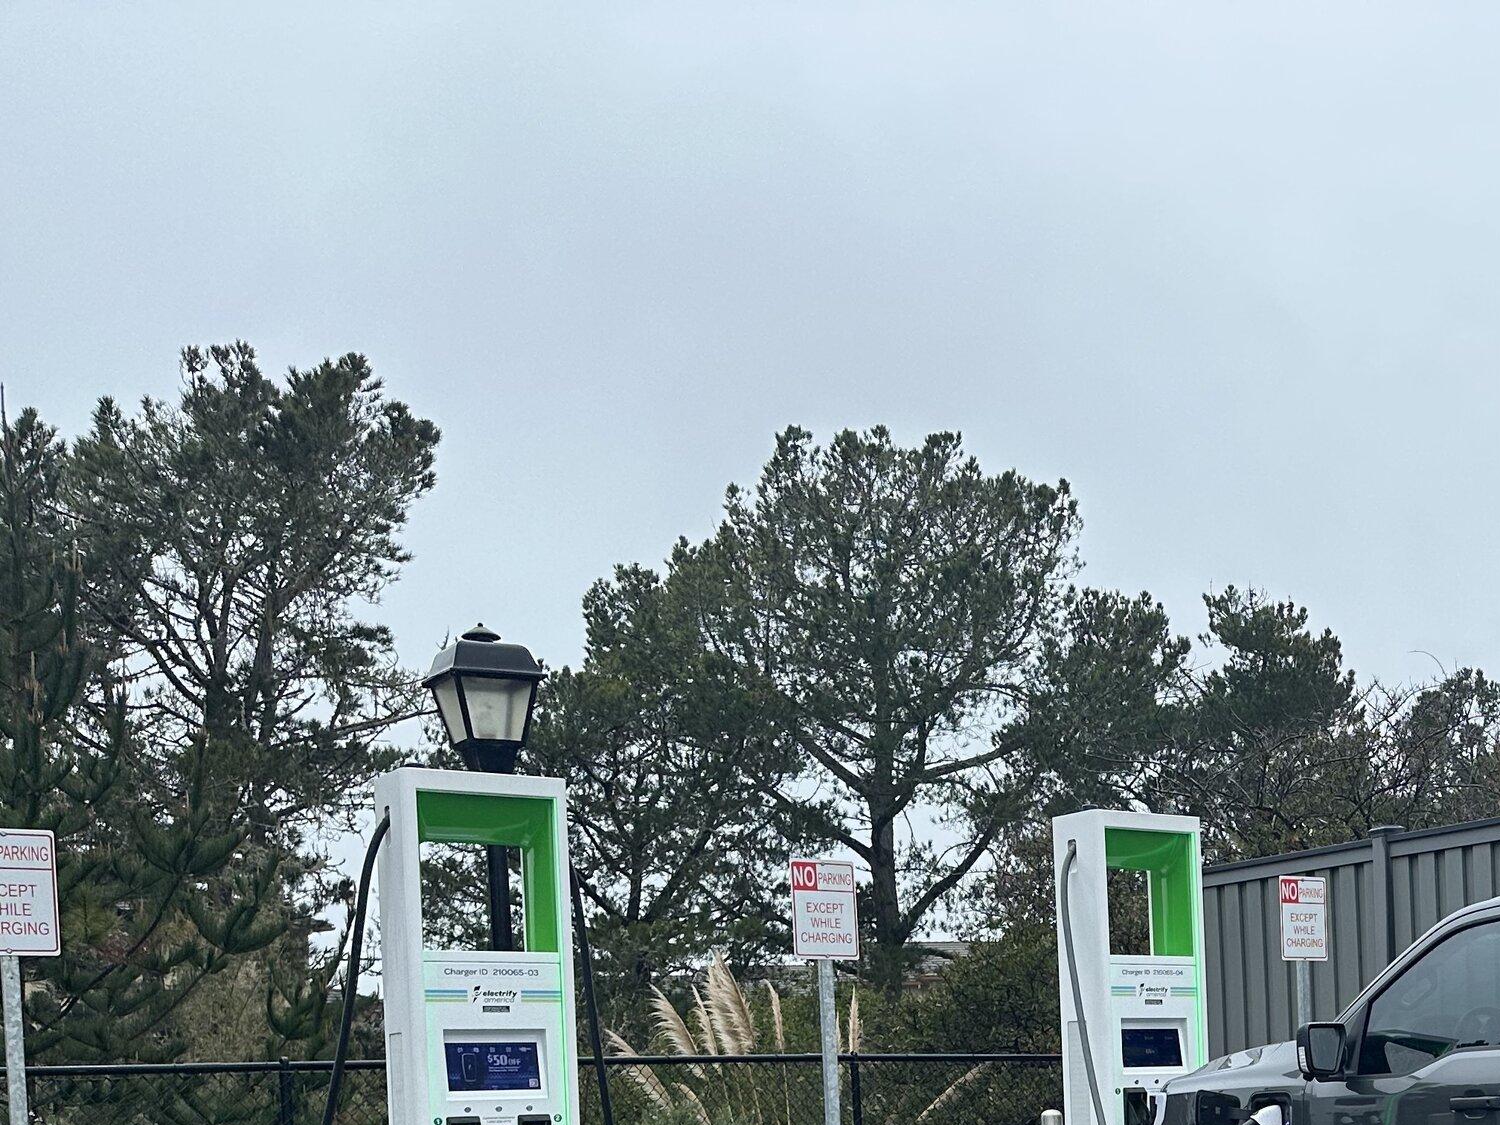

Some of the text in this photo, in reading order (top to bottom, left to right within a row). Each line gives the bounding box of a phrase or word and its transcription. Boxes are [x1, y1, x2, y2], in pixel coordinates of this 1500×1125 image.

[793, 866, 851, 887] NO PARKING
[0, 884, 37, 897] CEPT
[1281, 882, 1323, 900] NO PARKING
[0, 903, 32, 916] HILE
[806, 902, 844, 914] EXCEPT
[810, 918, 841, 929] WHILE
[1290, 913, 1317, 922] EXCEPT
[0, 921, 50, 936] RGING
[1293, 926, 1315, 934] WHILE
[801, 932, 852, 944] CHARGING
[1287, 938, 1323, 947] CHARGING
[444, 968, 539, 977] Charger ID 210065-03
[483, 990, 517, 999] electrify
[487, 1054, 508, 1066] $50
